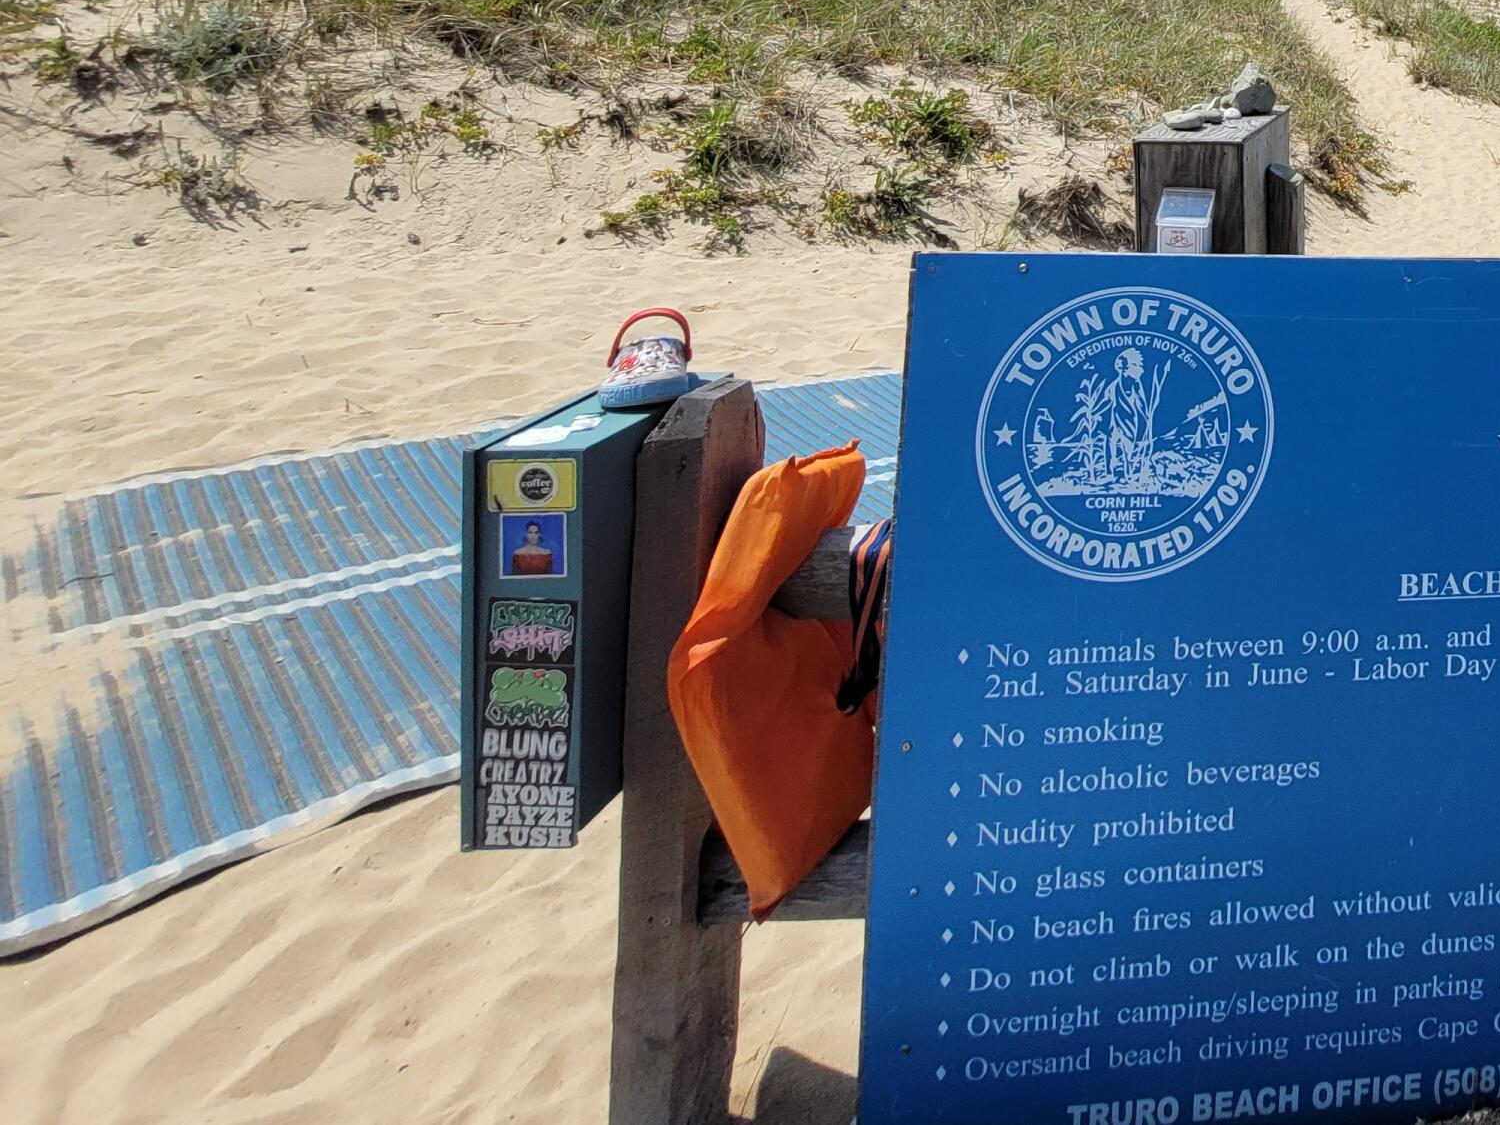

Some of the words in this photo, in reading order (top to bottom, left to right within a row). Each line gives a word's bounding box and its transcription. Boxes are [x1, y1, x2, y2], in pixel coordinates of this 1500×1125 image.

[1005, 305, 1104, 388] TOWN
[1112, 298, 1160, 326] OF
[1167, 303, 1254, 395] TRURO
[1066, 335, 1132, 369] EXPEDITION
[1135, 335, 1151, 346] OF
[1152, 338, 1179, 354] NOV
[997, 473, 1194, 569] INCORPORATED
[1085, 497, 1125, 509] CORN
[1130, 496, 1162, 508] HILL
[1101, 510, 1145, 522] PAMET
[987, 643, 1029, 667] No
[1048, 637, 1155, 665] animals
[1174, 636, 1284, 660] between
[1302, 629, 1359, 654] 9:00
[1376, 633, 1428, 651] a.m.
[1447, 623, 1491, 648] and
[984, 672, 1044, 698] 2nd.
[1066, 667, 1187, 696] Saturday
[1206, 664, 1230, 688] in
[1248, 663, 1307, 686] June
[1352, 656, 1429, 681] Labor
[1445, 654, 1496, 681] Day
[982, 723, 1024, 747] No
[1044, 716, 1163, 745] smoking
[487, 784, 575, 806] AYONE
[979, 773, 1022, 797] No
[1041, 764, 1168, 794] alcoholic
[1187, 761, 1320, 786] beverages
[484, 825, 571, 847] KUSH
[486, 805, 574, 827] PAYZE
[977, 818, 1075, 848] Nudity
[1093, 807, 1234, 846] prohibited
[974, 871, 1017, 895] No
[1035, 866, 1105, 897] glass
[1124, 856, 1263, 885] containers
[971, 919, 1014, 943] No
[1034, 911, 1113, 939] beach
[1133, 908, 1191, 932] fires
[1209, 895, 1314, 926] allowed
[1333, 891, 1431, 916] without
[969, 968, 1011, 991] Do
[1030, 964, 1074, 986] not
[1093, 954, 1171, 982] climb
[1189, 956, 1218, 974] or
[1235, 944, 1298, 970] walk
[1317, 946, 1347, 963] on
[1367, 936, 1404, 960] the
[1422, 932, 1494, 955] dunes
[967, 1004, 1100, 1036] Overnight
[1117, 986, 1339, 1027] camping/sleeping
[1356, 982, 1376, 1004] in
[1394, 974, 1483, 1007] parking
[965, 1047, 1090, 1080] Oversand
[1109, 1040, 1181, 1068] beach
[1199, 1032, 1288, 1060] driving
[1305, 1023, 1401, 1054] requires
[1418, 1018, 1478, 1043] Cape
[1067, 1096, 1179, 1125] TRURO
[1193, 1084, 1299, 1121] BEACH
[1312, 1072, 1422, 1109] OFFICE
